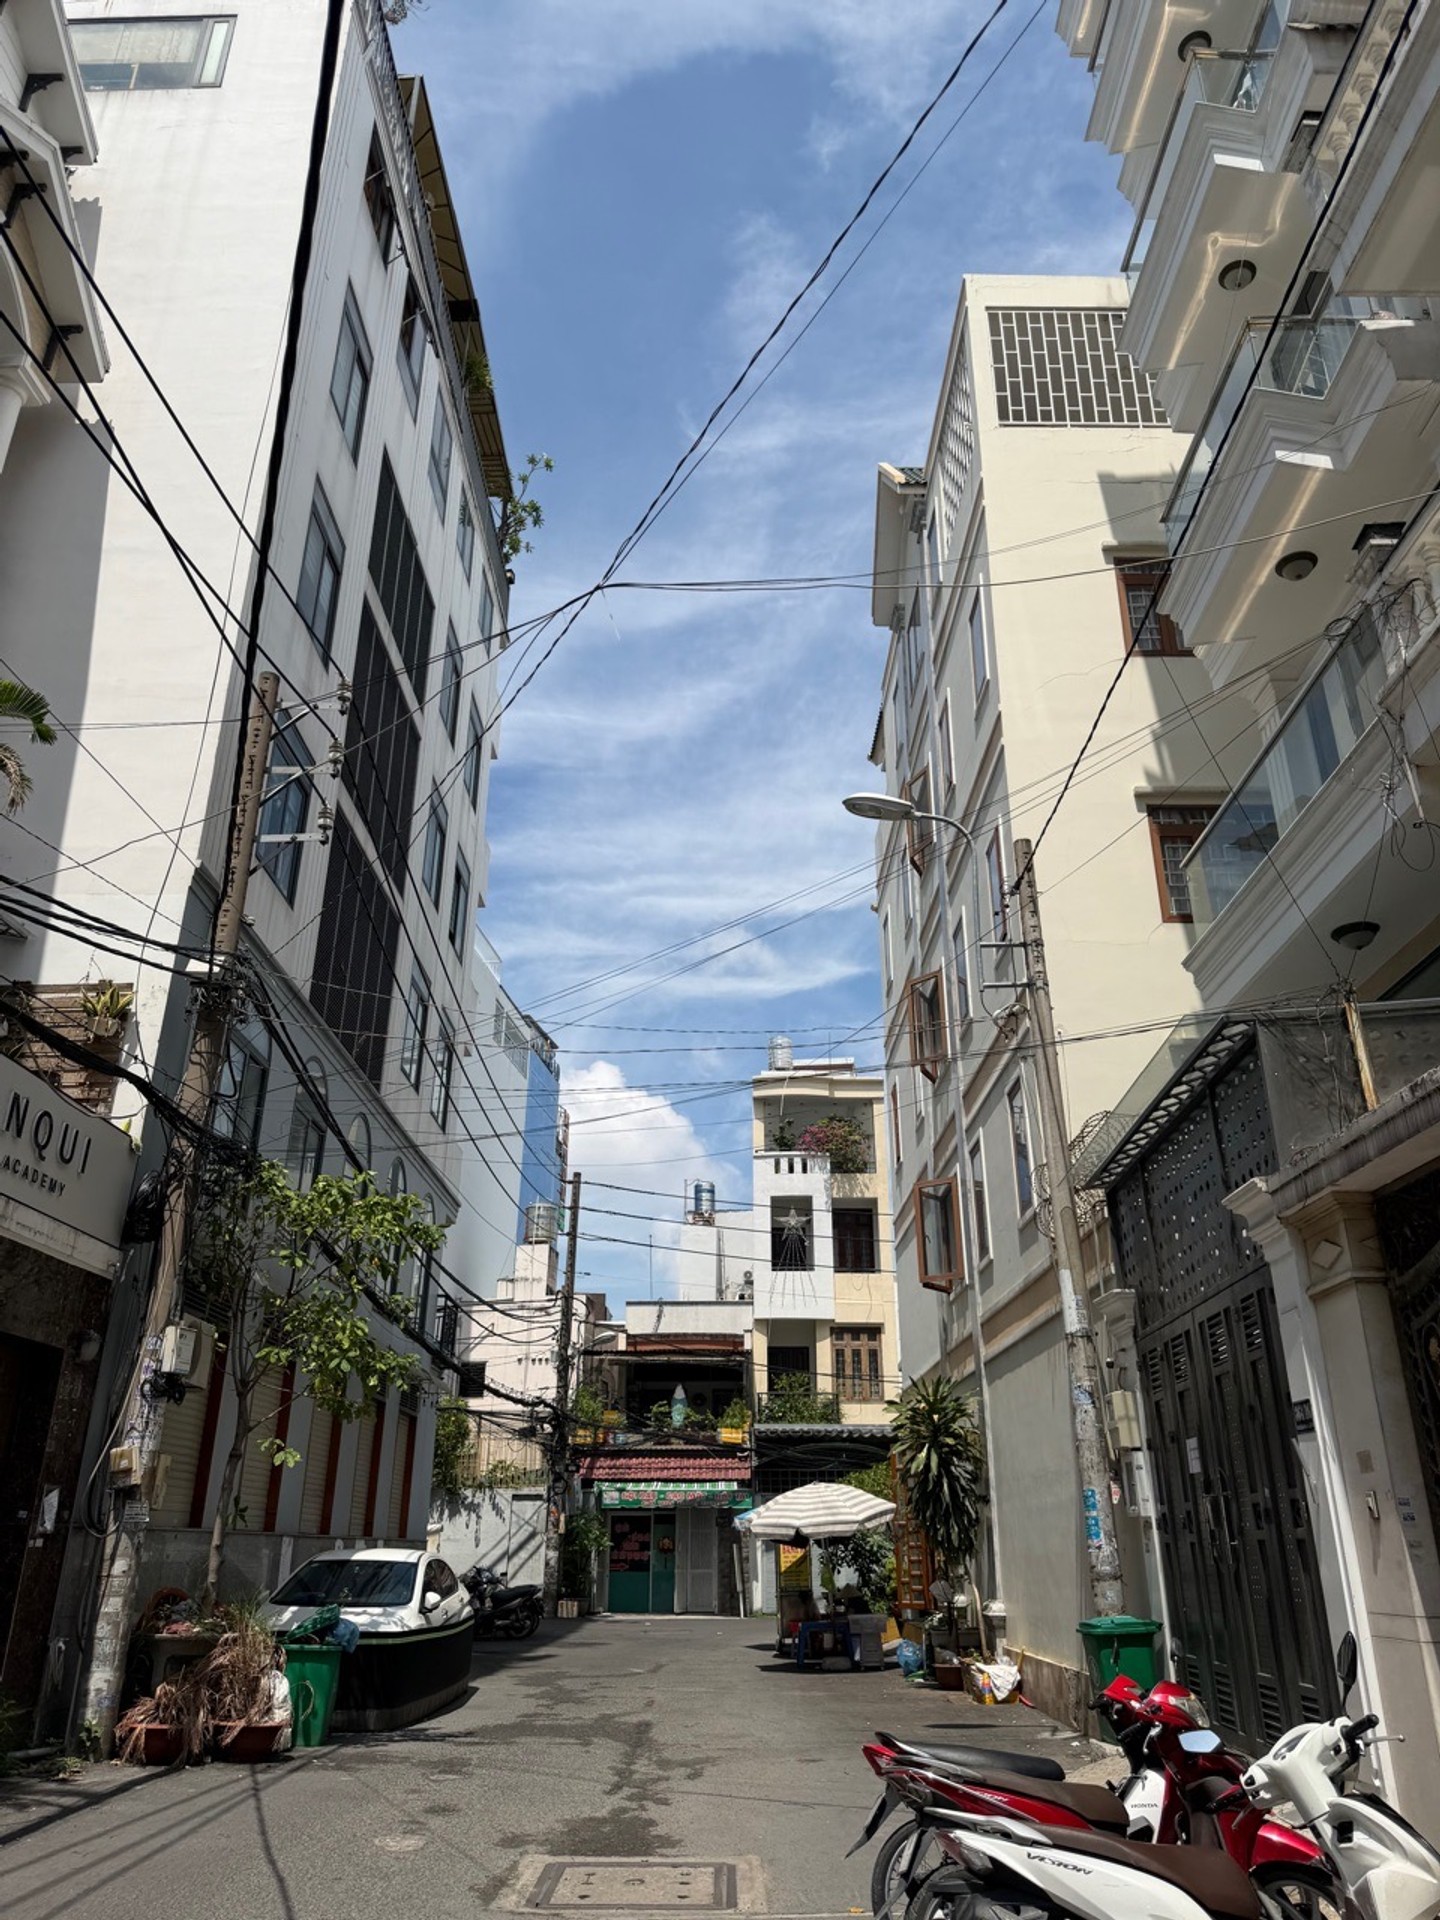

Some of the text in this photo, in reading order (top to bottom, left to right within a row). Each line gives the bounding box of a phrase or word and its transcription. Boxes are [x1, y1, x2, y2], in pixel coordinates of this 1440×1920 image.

[5, 1090, 91, 1173] NQUI
[3, 1155, 66, 1196] ACADEMY
[1026, 1852, 1093, 1875] VISION
